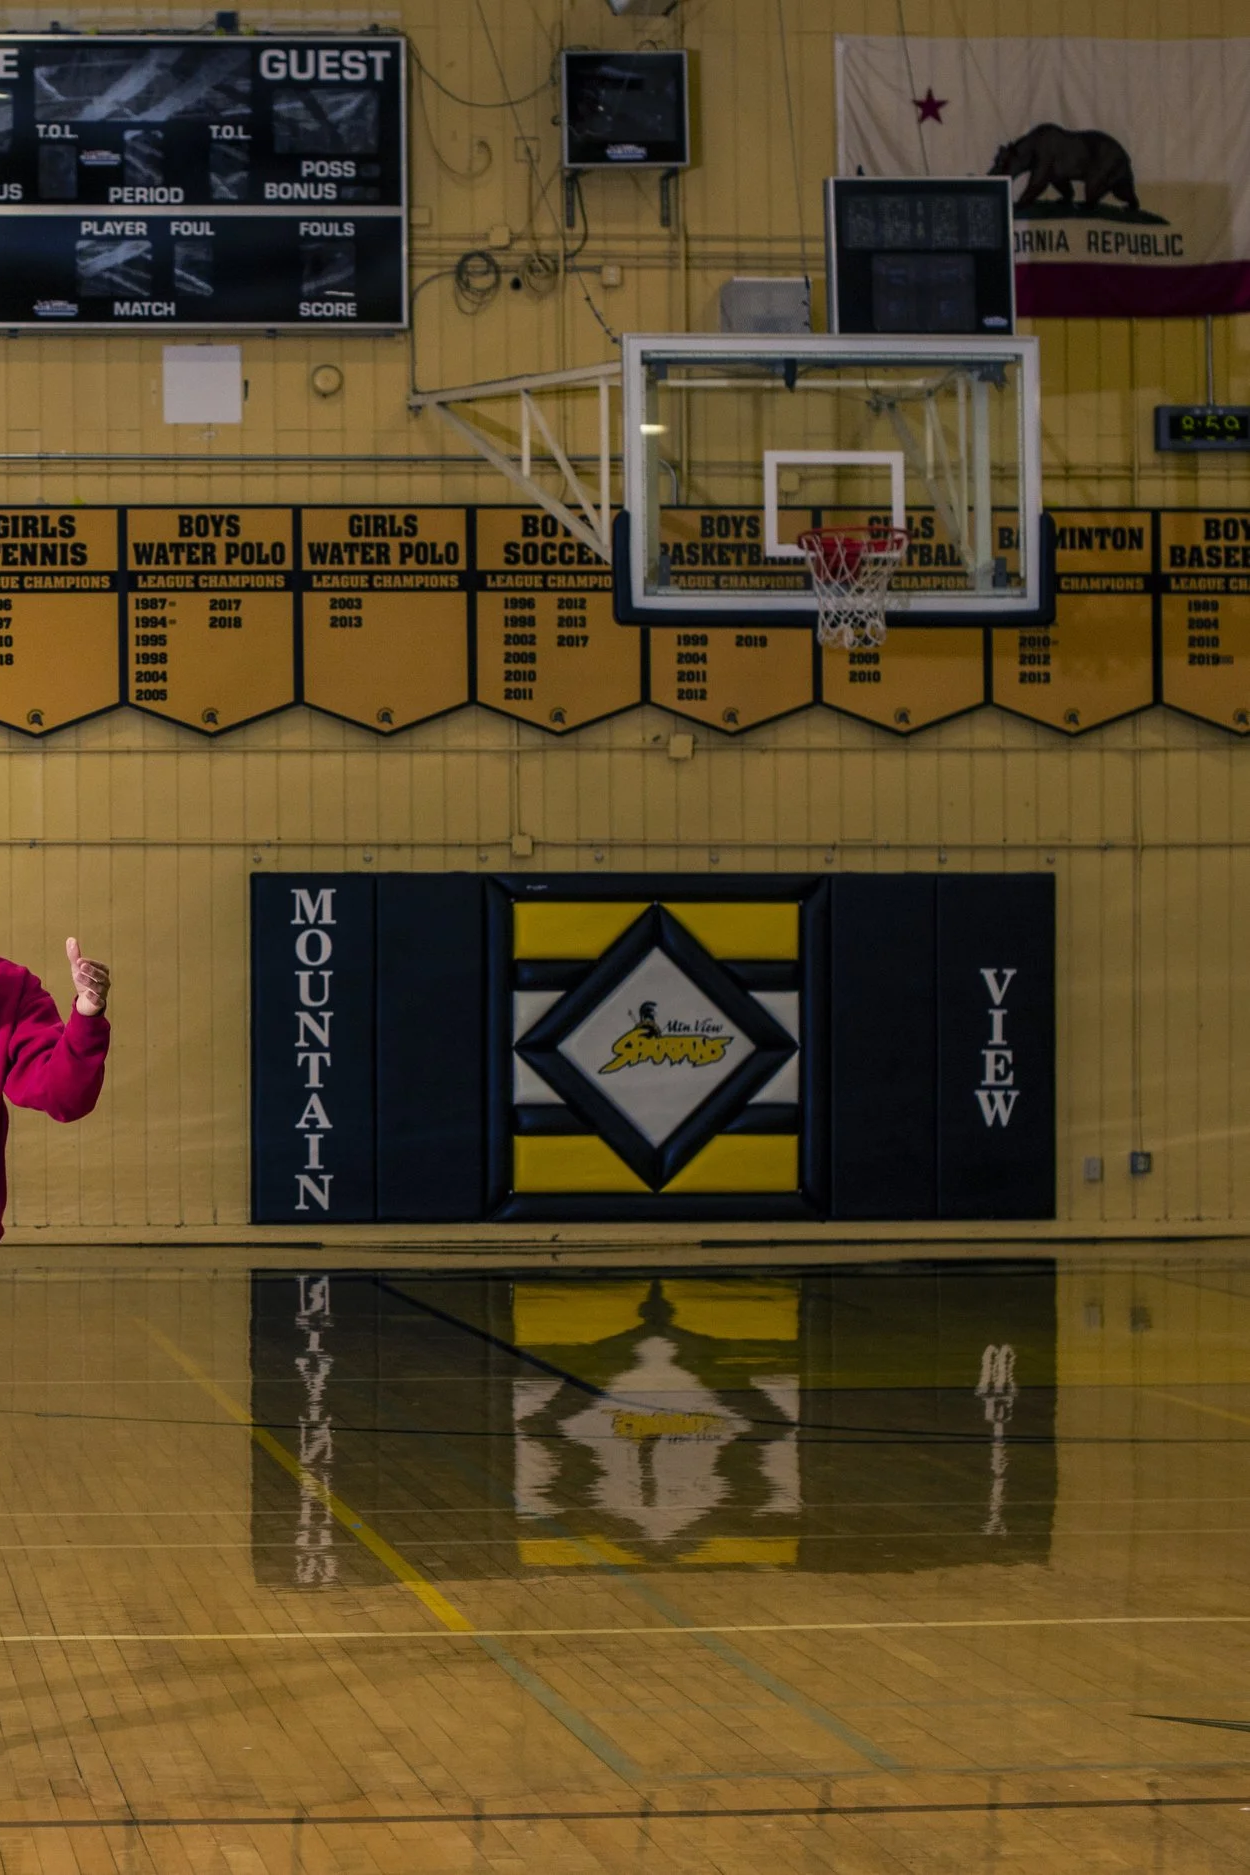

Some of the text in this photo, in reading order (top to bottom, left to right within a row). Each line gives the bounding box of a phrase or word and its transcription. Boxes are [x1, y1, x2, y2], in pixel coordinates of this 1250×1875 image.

[261, 50, 390, 80] GUEST
[36, 125, 78, 138] T.O.L.
[302, 161, 355, 177] POSS
[110, 187, 183, 203] PERIOD
[265, 183, 336, 199] BONUS
[81, 222, 146, 235] PLAYER
[171, 222, 214, 235] FOUL
[300, 222, 354, 236] FOULS
[1087, 231, 1183, 256] REPUBLIC
[114, 302, 175, 315] MATCH
[300, 303, 356, 316] SCORE
[178, 515, 240, 537] BOYS
[349, 514, 418, 537] GIRLS
[700, 515, 760, 538] BOYS
[1204, 518, 1250, 541] BOY
[133, 542, 285, 565] WATER POLO
[308, 542, 459, 565] WATER POLO
[24, 576, 110, 588] CHAMPIONS
[138, 575, 284, 588] LEAGUE CHAMPIONS
[313, 575, 458, 587] LEAGUE CHAMPIONS
[487, 575, 543, 587] LEAGUE
[720, 576, 804, 590] CHAMPIONS
[1061, 578, 1143, 590] CHAMPIONS
[1171, 578, 1224, 590] LEAGUE
[210, 599, 241, 611] 2017
[330, 598, 362, 609] 2003
[557, 598, 586, 610] 2012
[209, 616, 242, 628] 2018
[330, 616, 362, 628] 2013
[557, 616, 586, 628] 2013
[1188, 618, 1219, 629] 2004
[136, 635, 167, 646] 1995
[504, 634, 536, 645] 2002
[557, 635, 588, 647] 2017
[677, 634, 708, 646] 1999
[736, 635, 767, 648] 2019
[1188, 636, 1219, 648] 2010
[136, 652, 167, 664] 1998
[504, 652, 536, 664] 2009
[677, 652, 707, 664] 2004
[136, 671, 167, 683] 2004
[504, 670, 536, 682] 2010
[677, 671, 706, 682] 2011
[849, 671, 881, 682] 2010
[136, 689, 167, 701] 2005
[504, 688, 533, 700] 2011
[677, 688, 707, 700] 2012
[290, 888, 337, 1211] MOUNTAIN
[977, 968, 1019, 1128] VIEW
